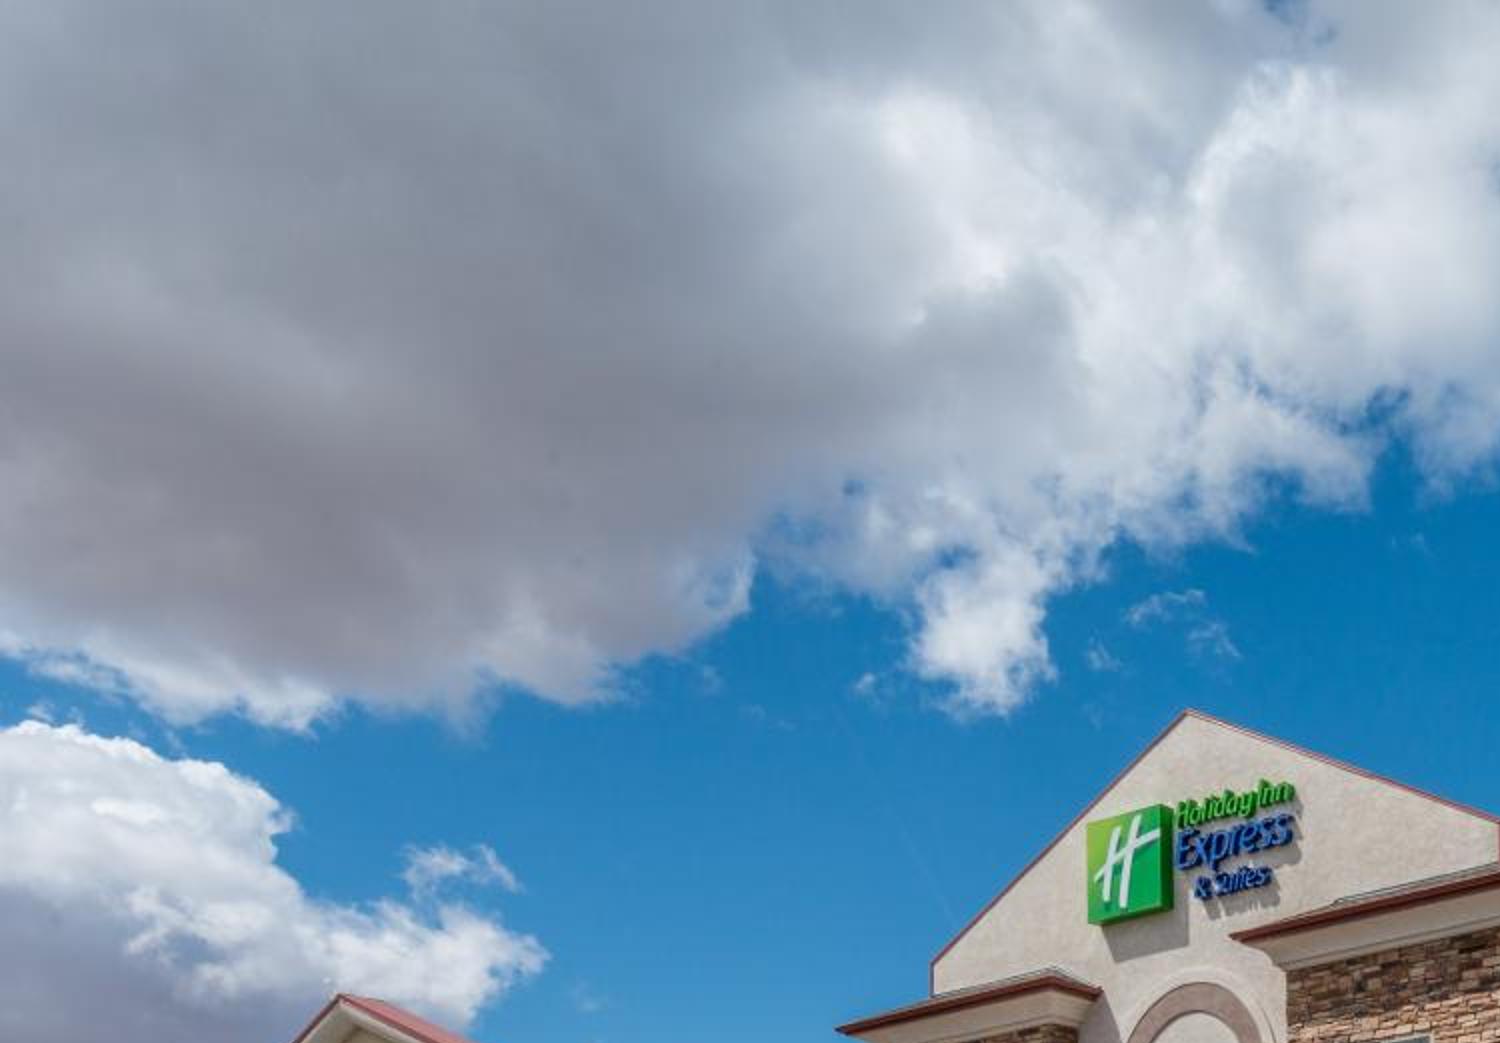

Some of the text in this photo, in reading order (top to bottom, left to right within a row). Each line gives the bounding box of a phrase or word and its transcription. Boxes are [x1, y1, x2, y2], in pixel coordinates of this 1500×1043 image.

[1177, 779, 1296, 828] Holiday Inn
[1094, 814, 1161, 909] H
[1175, 813, 1294, 870] Express
[1193, 867, 1273, 900] & Suites
